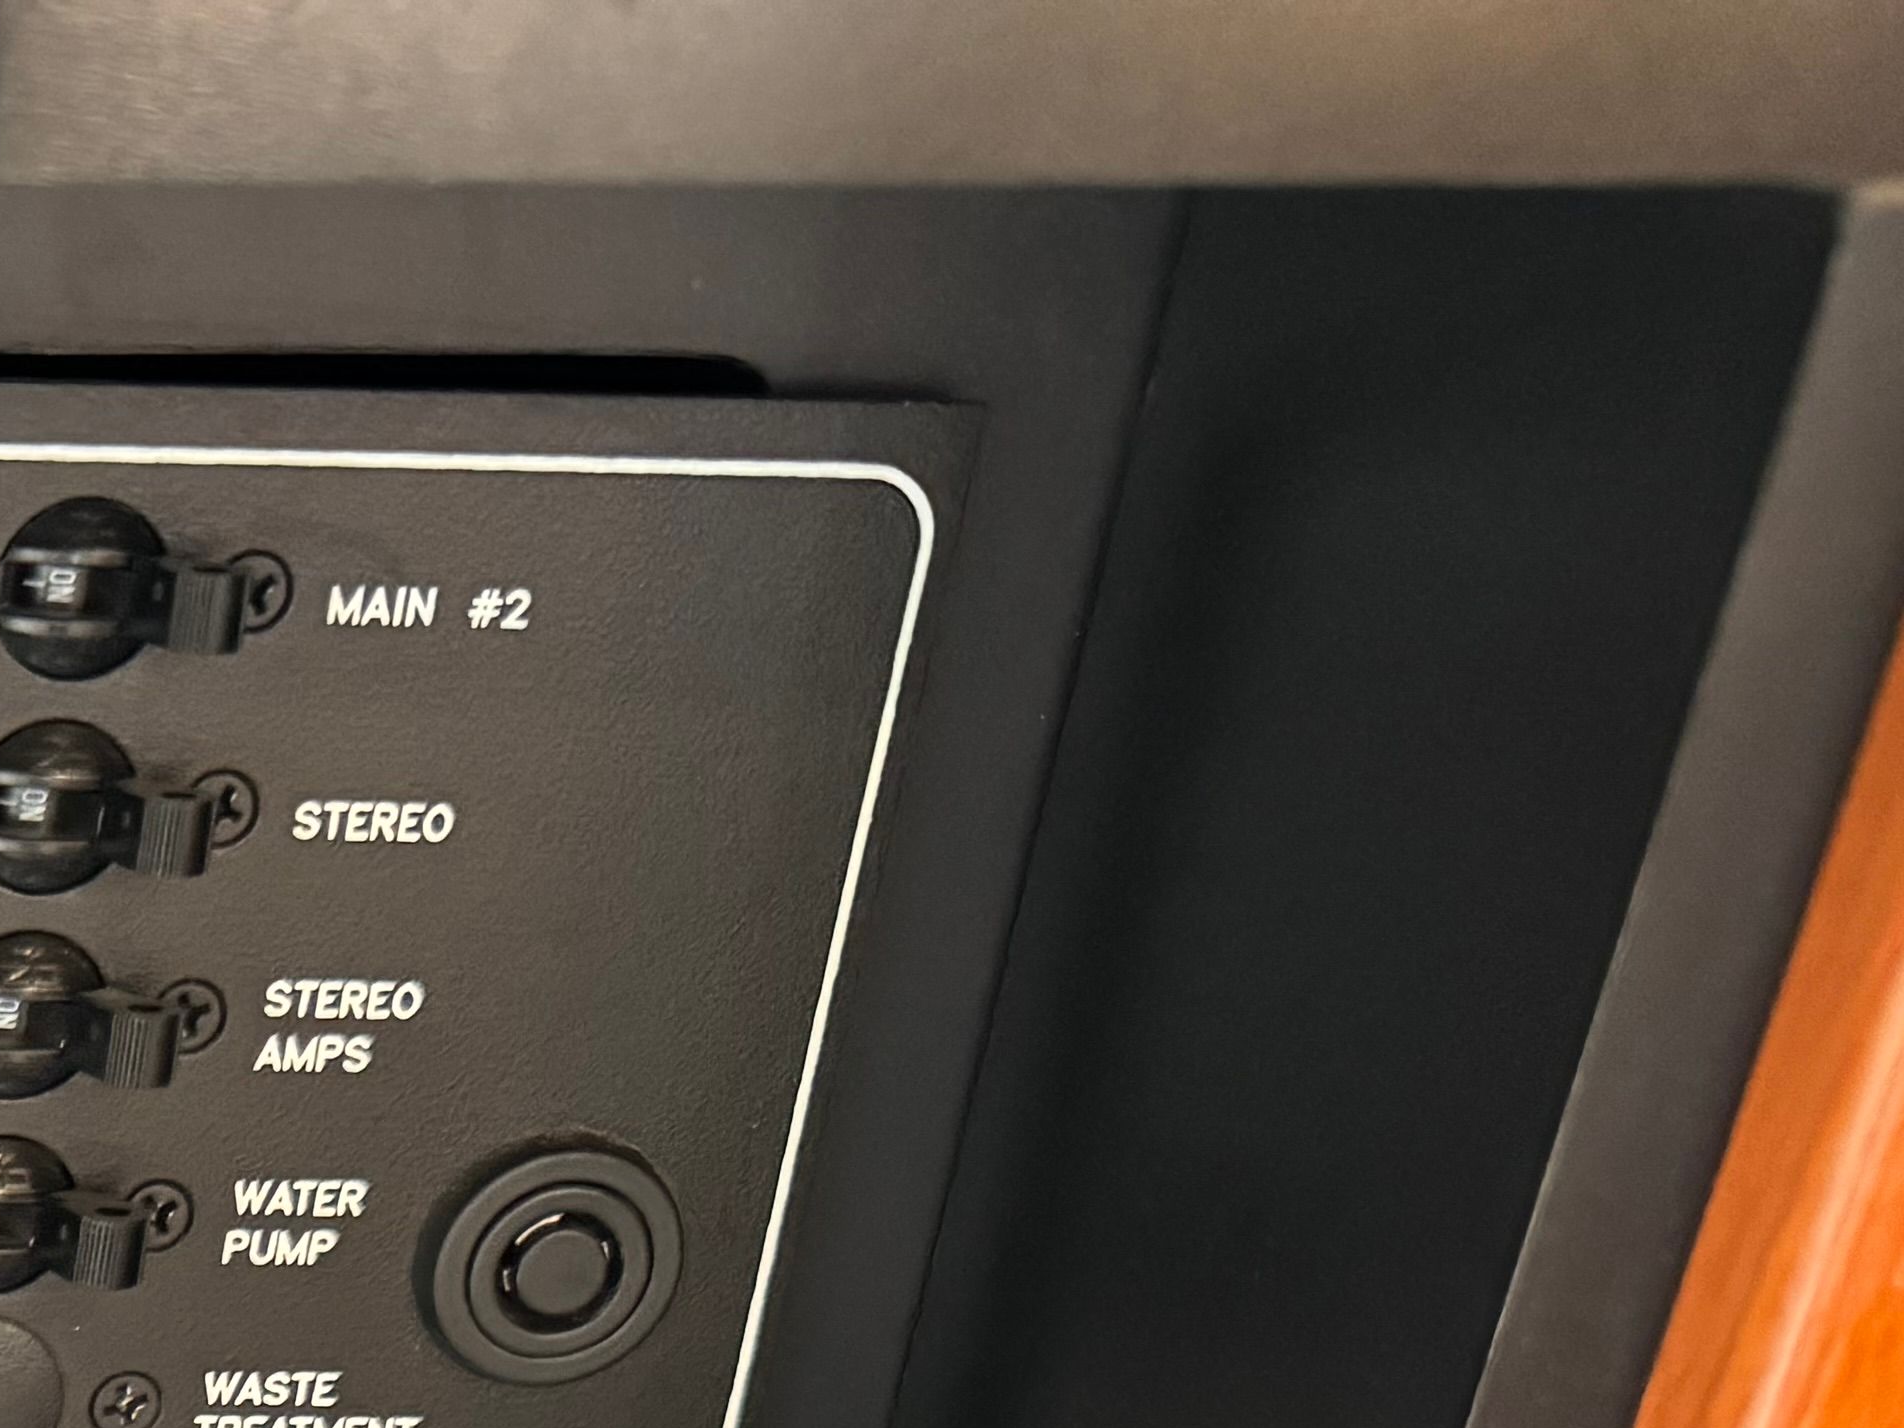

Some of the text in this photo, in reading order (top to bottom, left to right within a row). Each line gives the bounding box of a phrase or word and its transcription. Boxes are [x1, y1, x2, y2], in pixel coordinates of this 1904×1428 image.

[326, 583, 532, 630] MAIN #2
[292, 799, 456, 843] STEREO
[263, 977, 425, 1021] STEREO
[252, 1033, 374, 1073] AMPS
[234, 1178, 370, 1218] WATER
[221, 1228, 340, 1266] PUMP
[204, 1370, 343, 1407] WASTE
